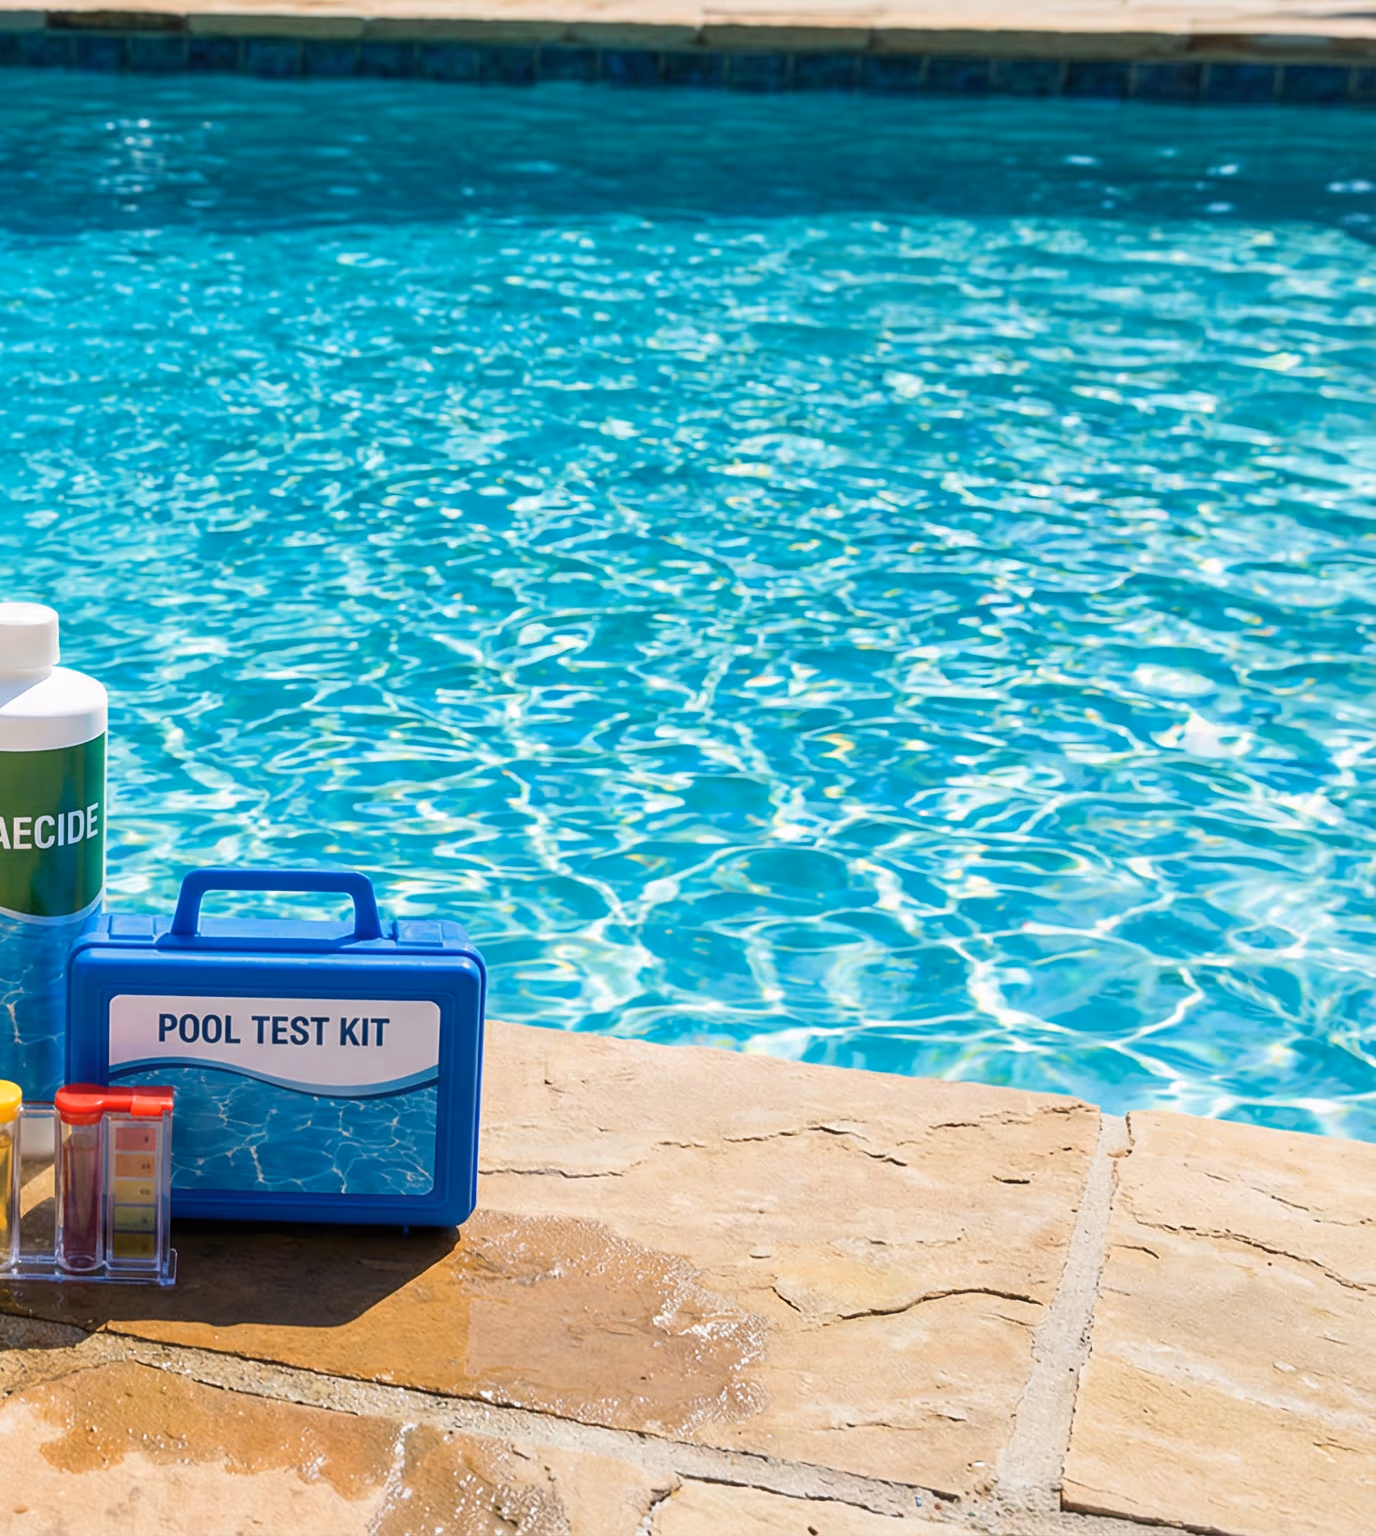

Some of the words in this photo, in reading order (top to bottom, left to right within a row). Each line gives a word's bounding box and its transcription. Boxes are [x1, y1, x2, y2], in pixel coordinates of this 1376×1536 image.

[158, 1013, 241, 1044] POOL
[251, 1015, 330, 1046] TEST
[339, 1017, 391, 1047] KIT
